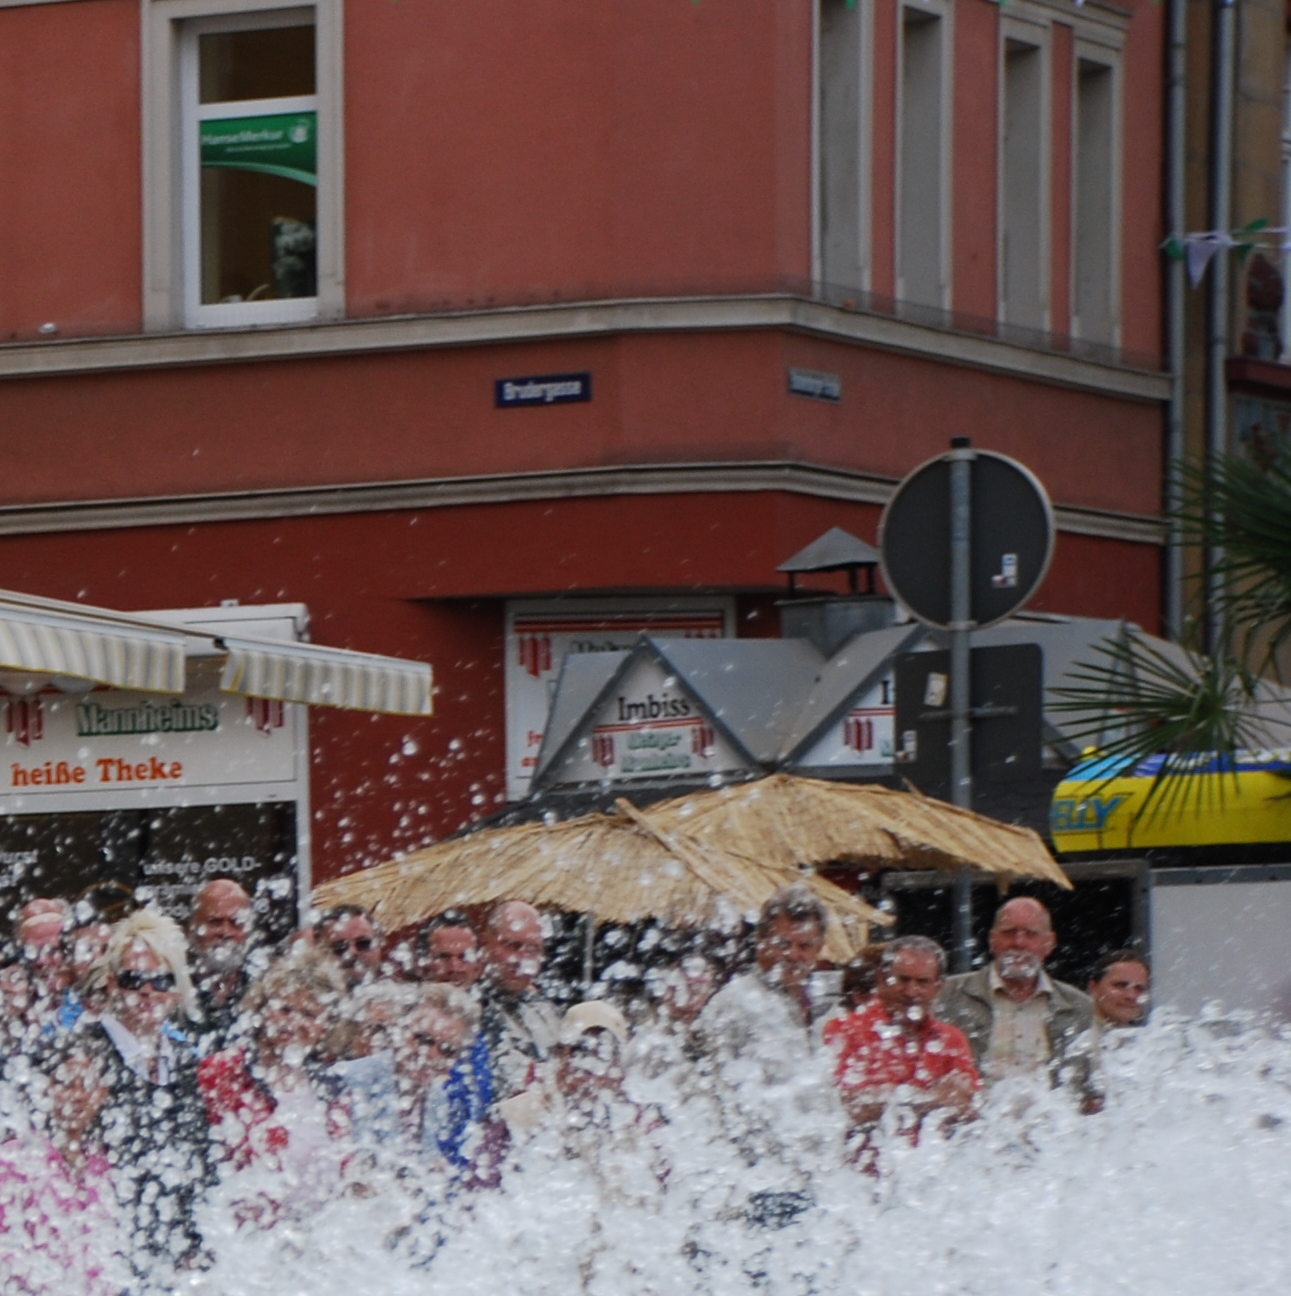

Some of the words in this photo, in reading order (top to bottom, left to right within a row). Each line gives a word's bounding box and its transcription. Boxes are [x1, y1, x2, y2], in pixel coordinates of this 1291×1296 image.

[617, 692, 691, 721] Imbiss
[10, 761, 86, 787] heiße
[95, 756, 183, 783] Theke
